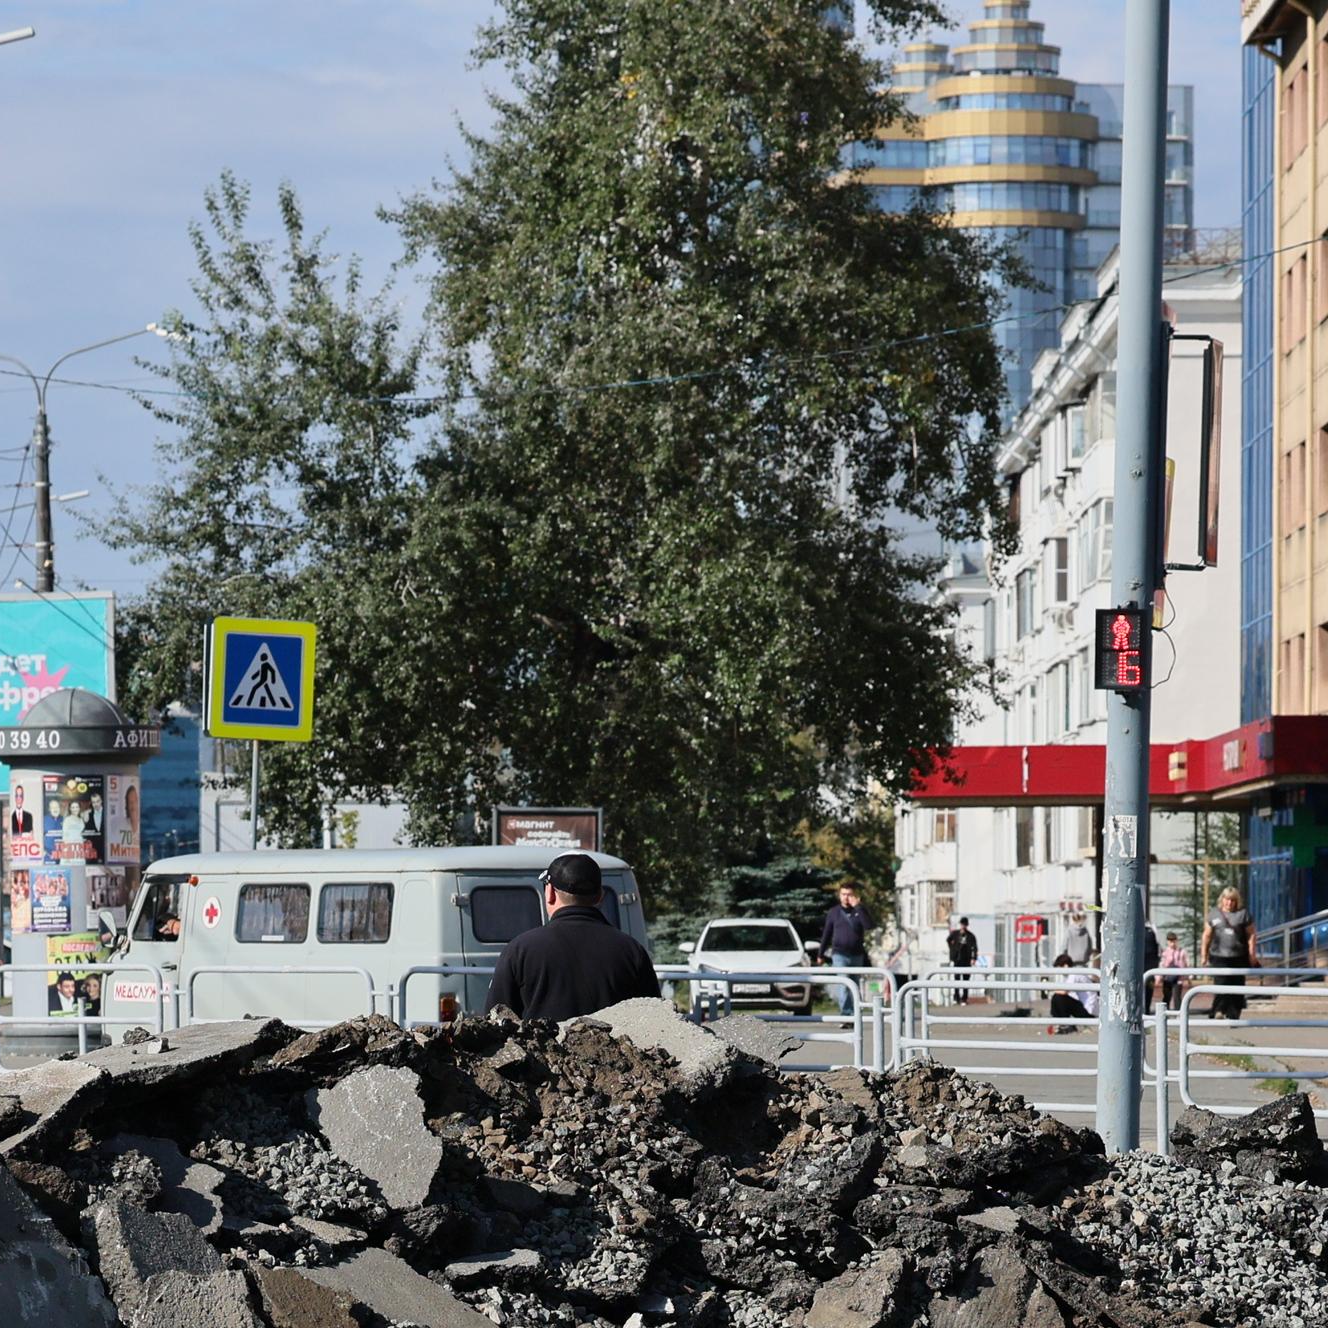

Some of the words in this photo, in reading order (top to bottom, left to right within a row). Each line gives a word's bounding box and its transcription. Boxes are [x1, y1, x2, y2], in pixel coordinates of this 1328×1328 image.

[1118, 651, 1140, 685] 6
[10, 731, 30, 749] 39
[36, 730, 60, 749] 40
[113, 730, 160, 748] АФИШ
[120, 830, 133, 845] 70
[115, 984, 170, 999] МЕДСЛУЖА
